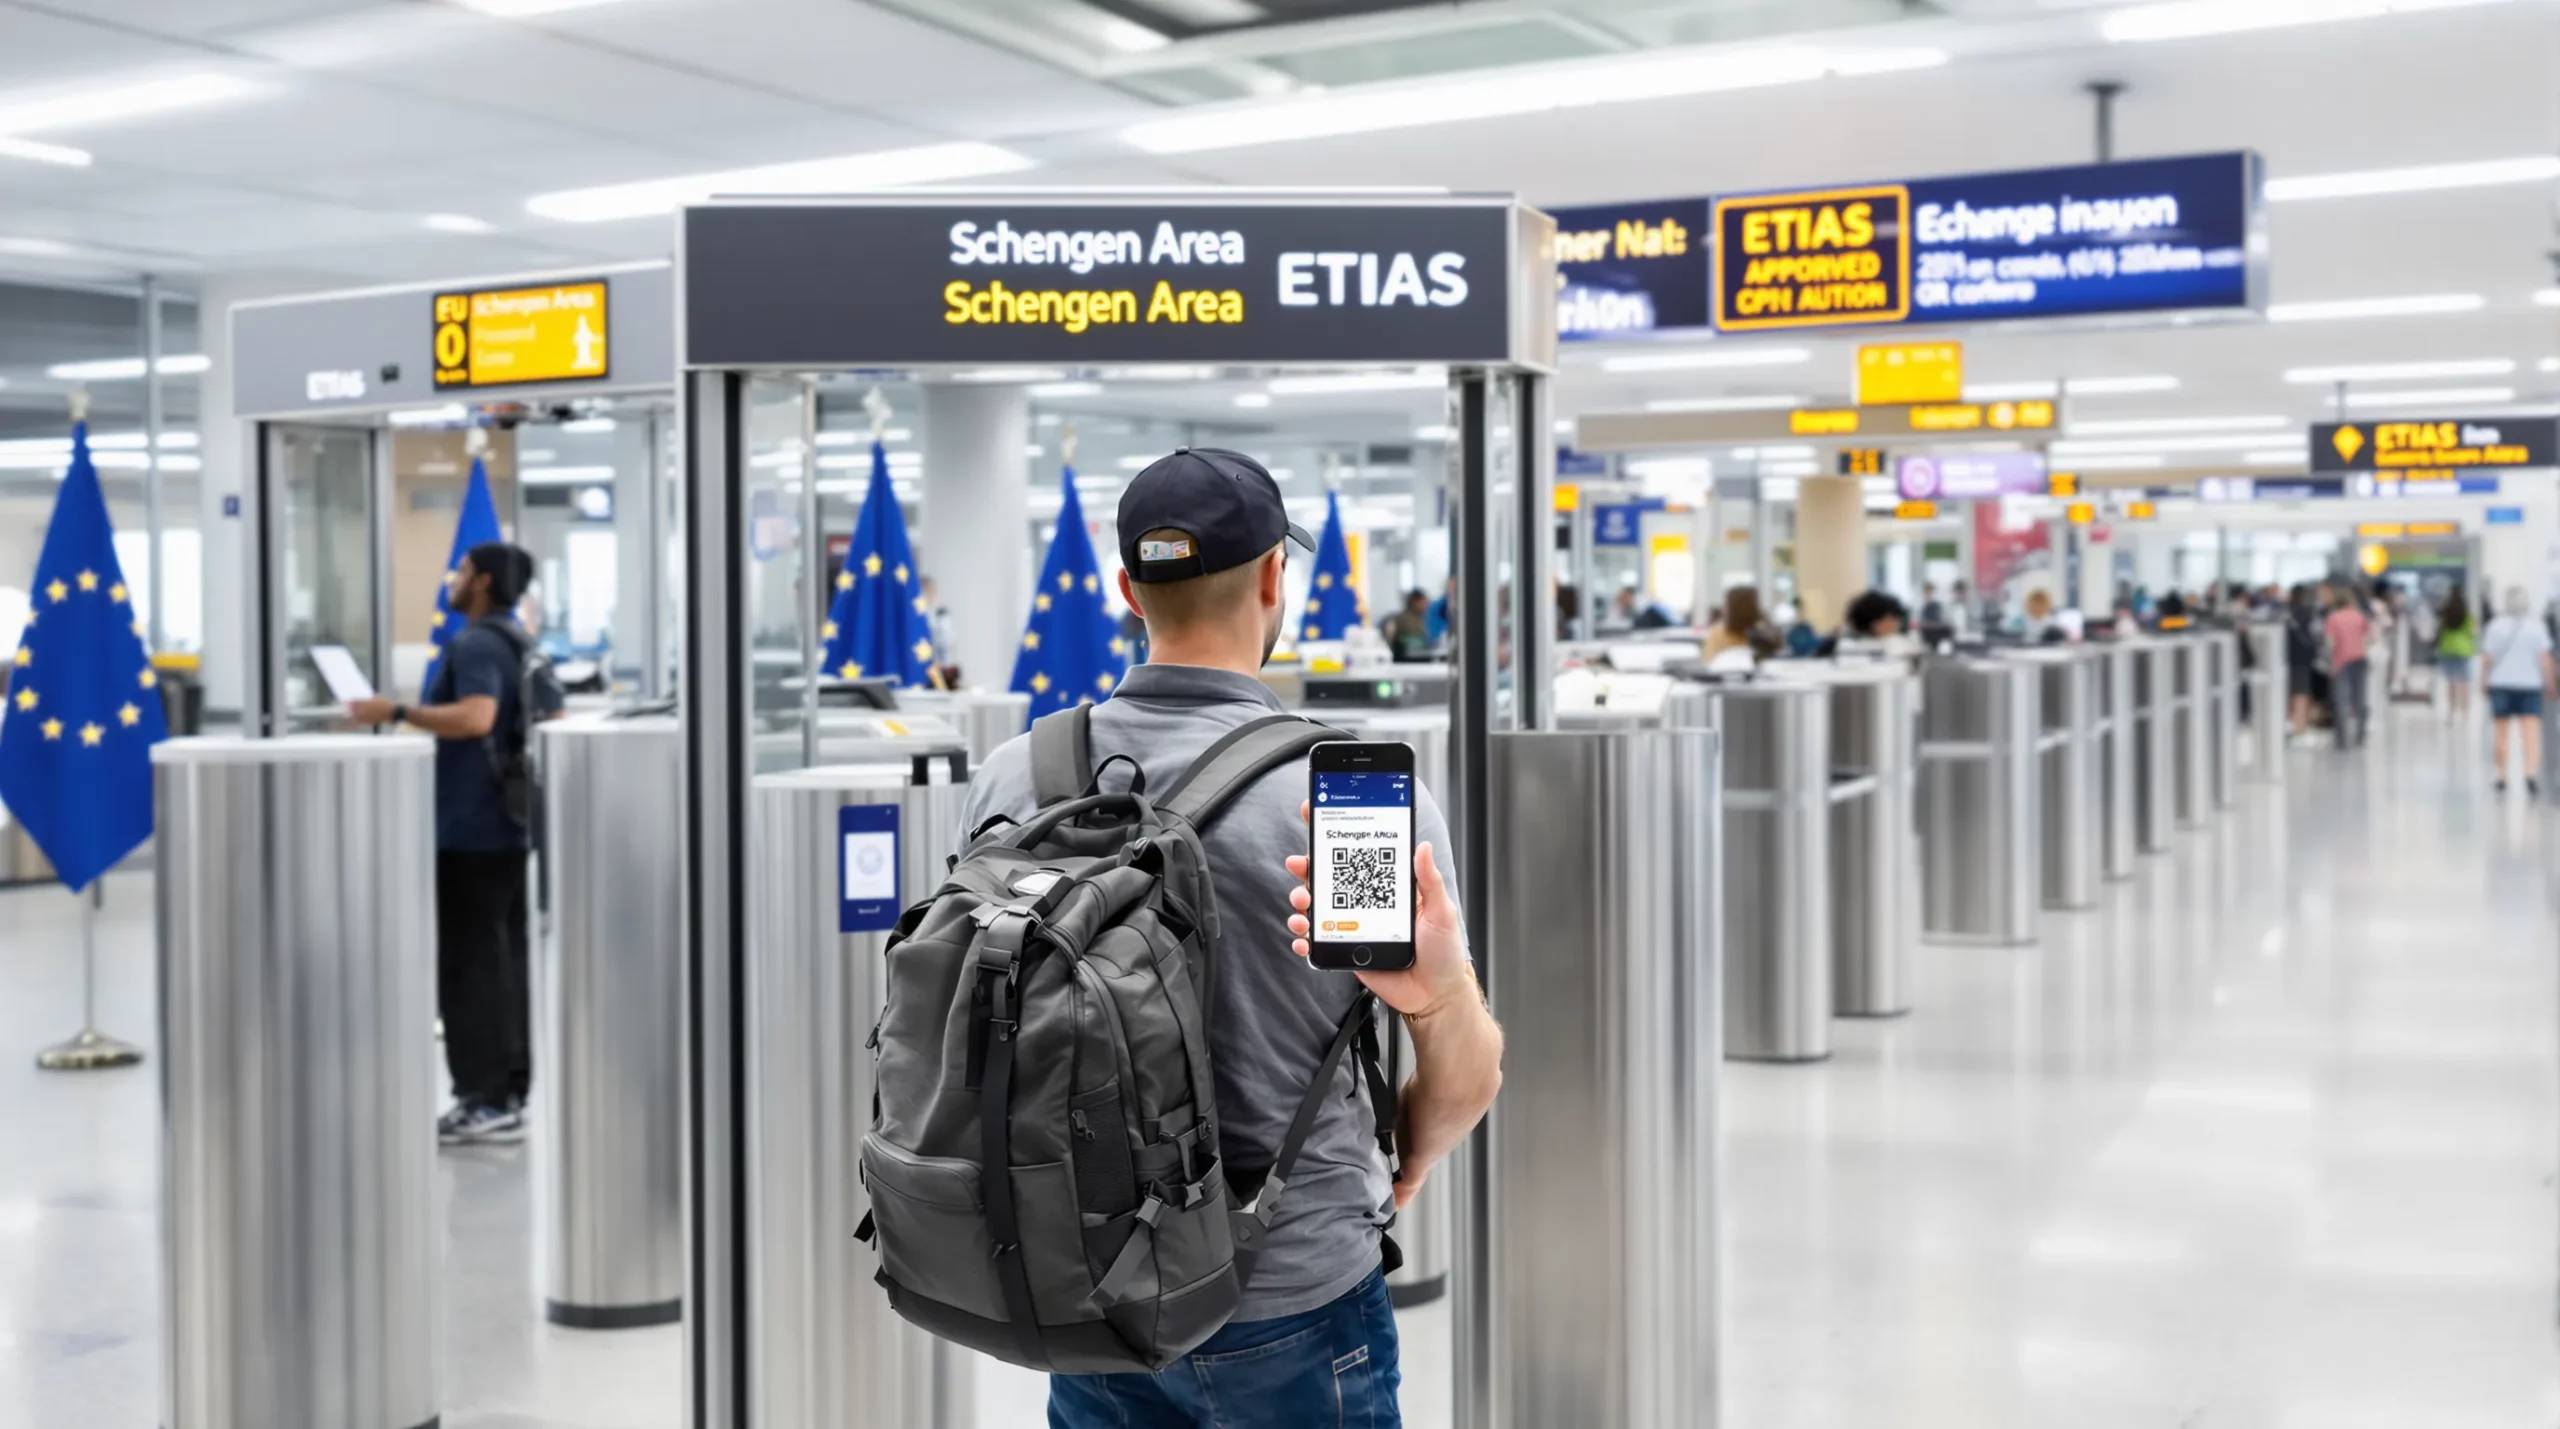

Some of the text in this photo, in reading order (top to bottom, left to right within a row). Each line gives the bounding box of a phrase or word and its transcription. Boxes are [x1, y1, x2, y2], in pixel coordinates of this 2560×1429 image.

[950, 221, 1245, 273] Schengen Area
[1553, 229, 1612, 262] ner
[1742, 202, 1874, 254] ETIAS
[1277, 252, 1469, 306] ETIAS
[944, 281, 1243, 332] Schengen Area
[2374, 421, 2459, 449] ETIAS
